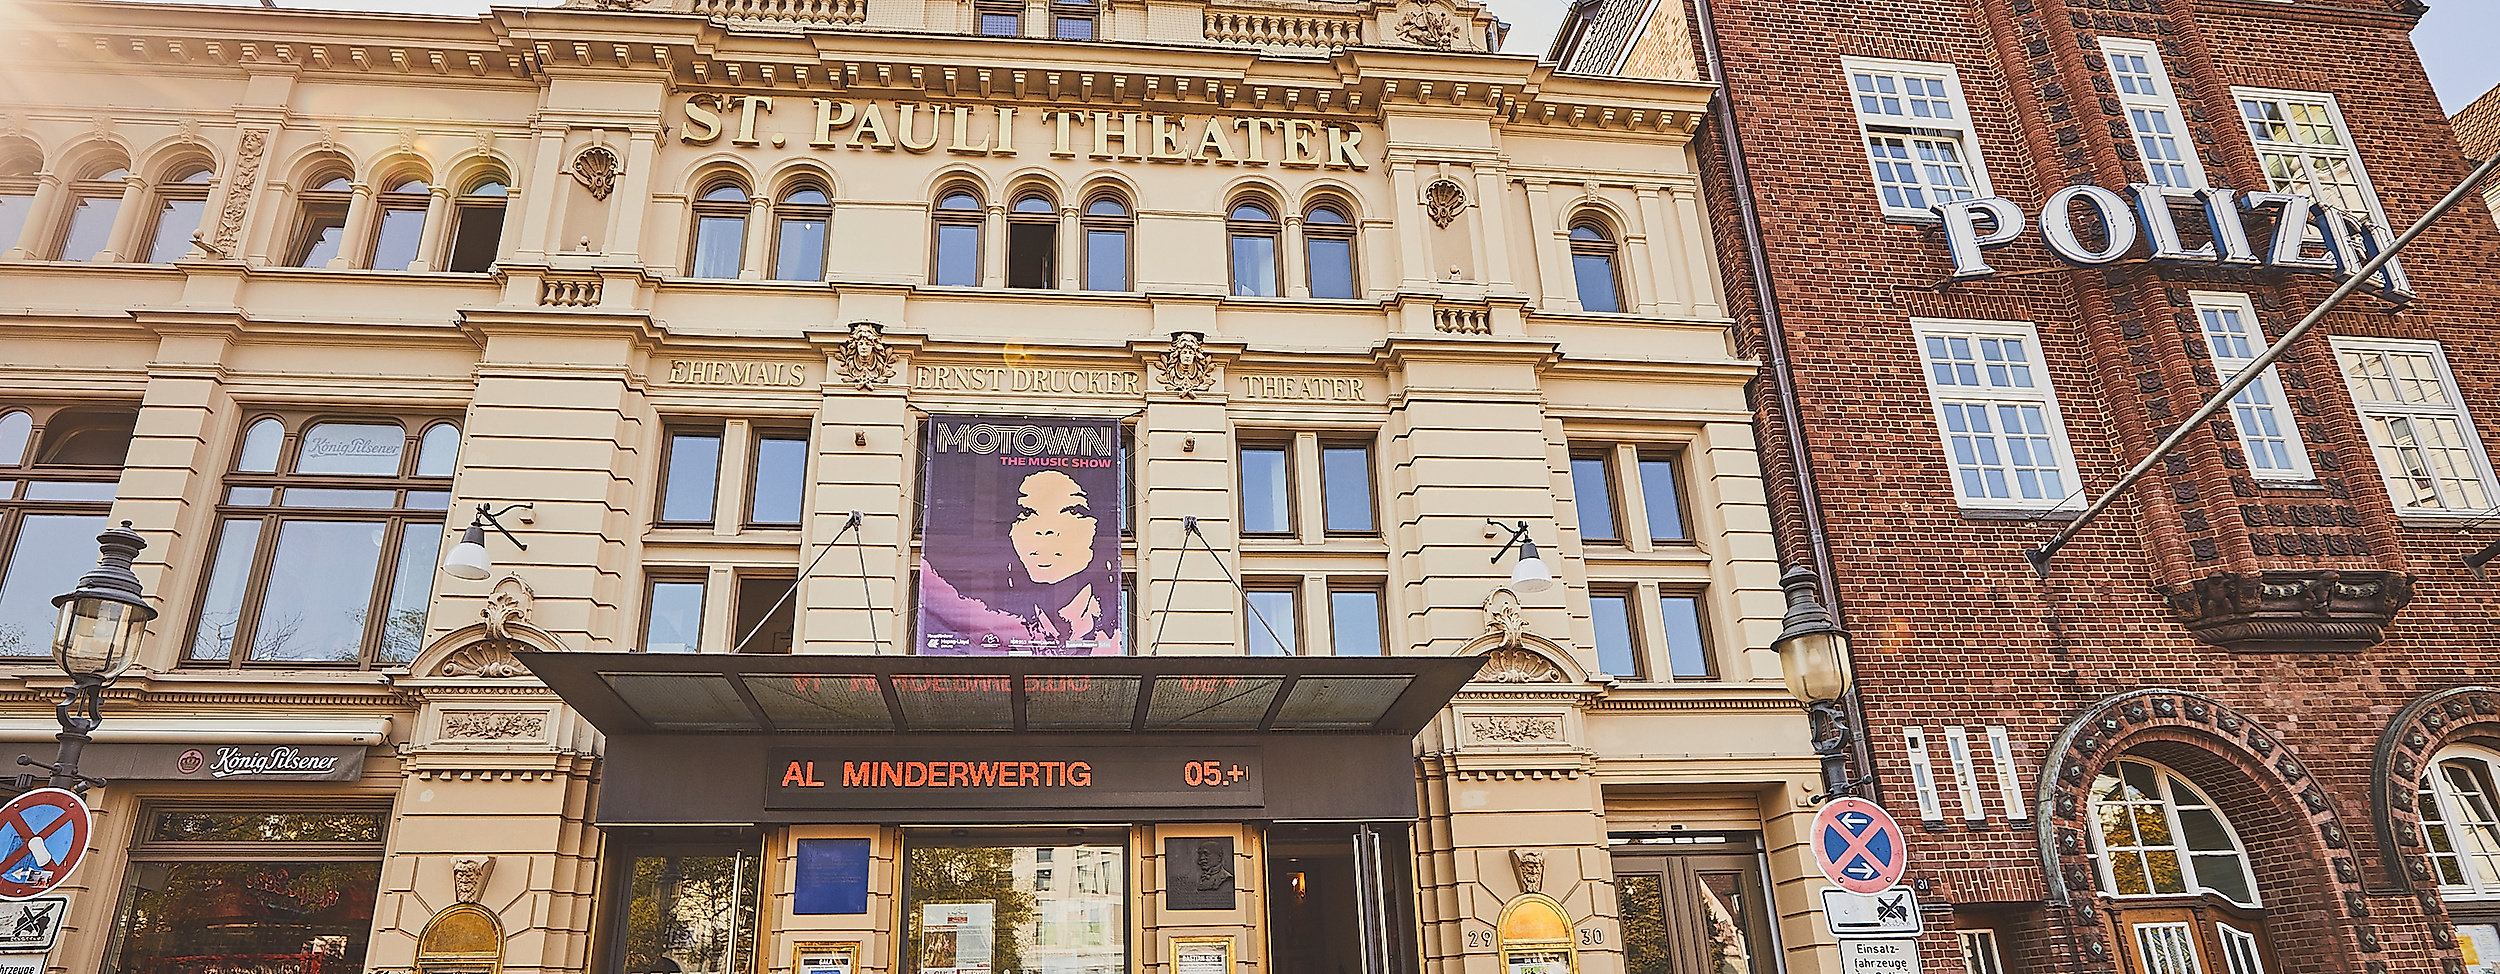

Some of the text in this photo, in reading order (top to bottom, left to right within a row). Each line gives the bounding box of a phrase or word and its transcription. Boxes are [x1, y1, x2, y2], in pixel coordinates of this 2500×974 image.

[680, 93, 1369, 171] ST. PAULI THEATER
[1931, 182, 2417, 299] POLIZEI
[667, 360, 806, 387] EHEMALS
[915, 365, 1141, 394] ERNST DRUCKER
[1240, 374, 1365, 401] THEATER
[308, 438, 400, 456] König Pilsener
[936, 422, 1112, 457] MOTOWN
[1000, 456, 1112, 468] THE MUSIC SHOW
[210, 746, 339, 774] König Pilsener
[782, 761, 825, 787] AL
[842, 761, 1092, 787] MINDERWERTIG
[1918, 879, 1930, 890] 31
[1468, 930, 1493, 947] 29
[1581, 928, 1604, 945] 30
[1856, 943, 1900, 954] Einsatz-
[1854, 957, 1908, 971] fahrzeuge
